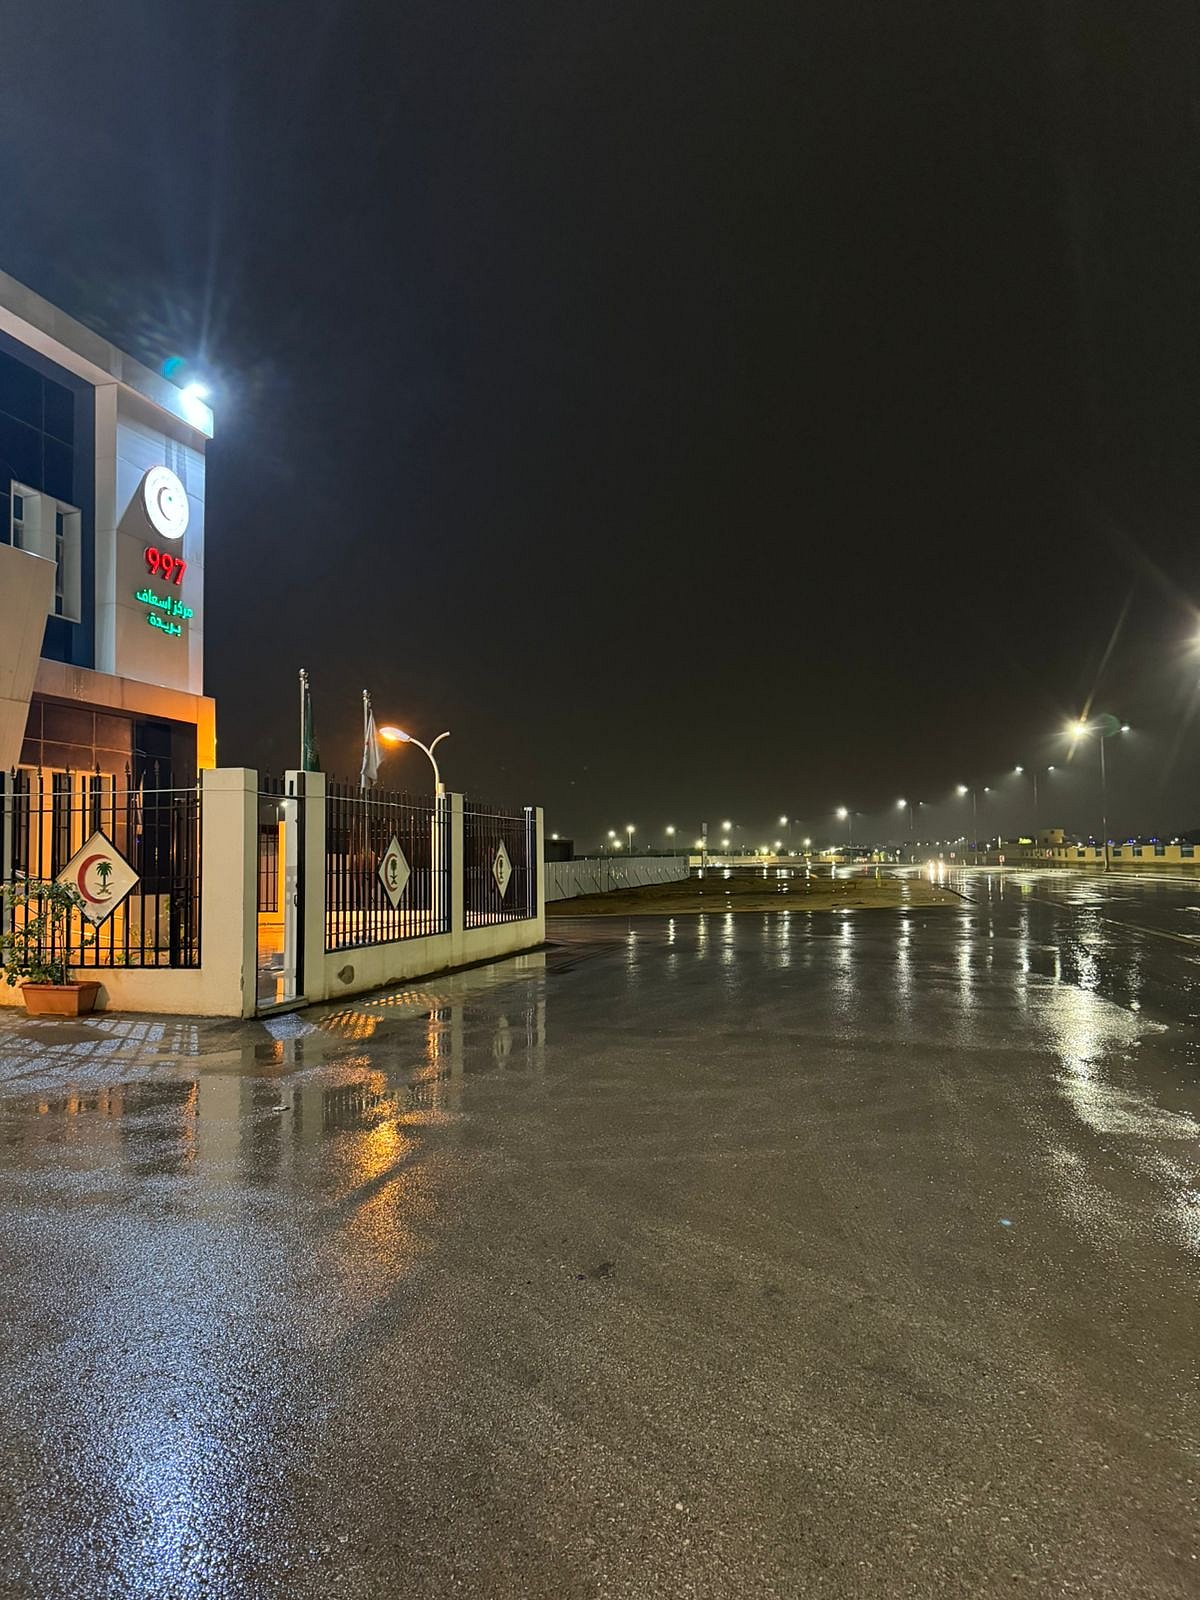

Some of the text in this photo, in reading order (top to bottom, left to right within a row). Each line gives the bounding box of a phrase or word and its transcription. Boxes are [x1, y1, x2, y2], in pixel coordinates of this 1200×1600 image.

[145, 547, 187, 586] 997
[135, 589, 193, 619] مركز إسعاف
[147, 612, 182, 637] بريدة
